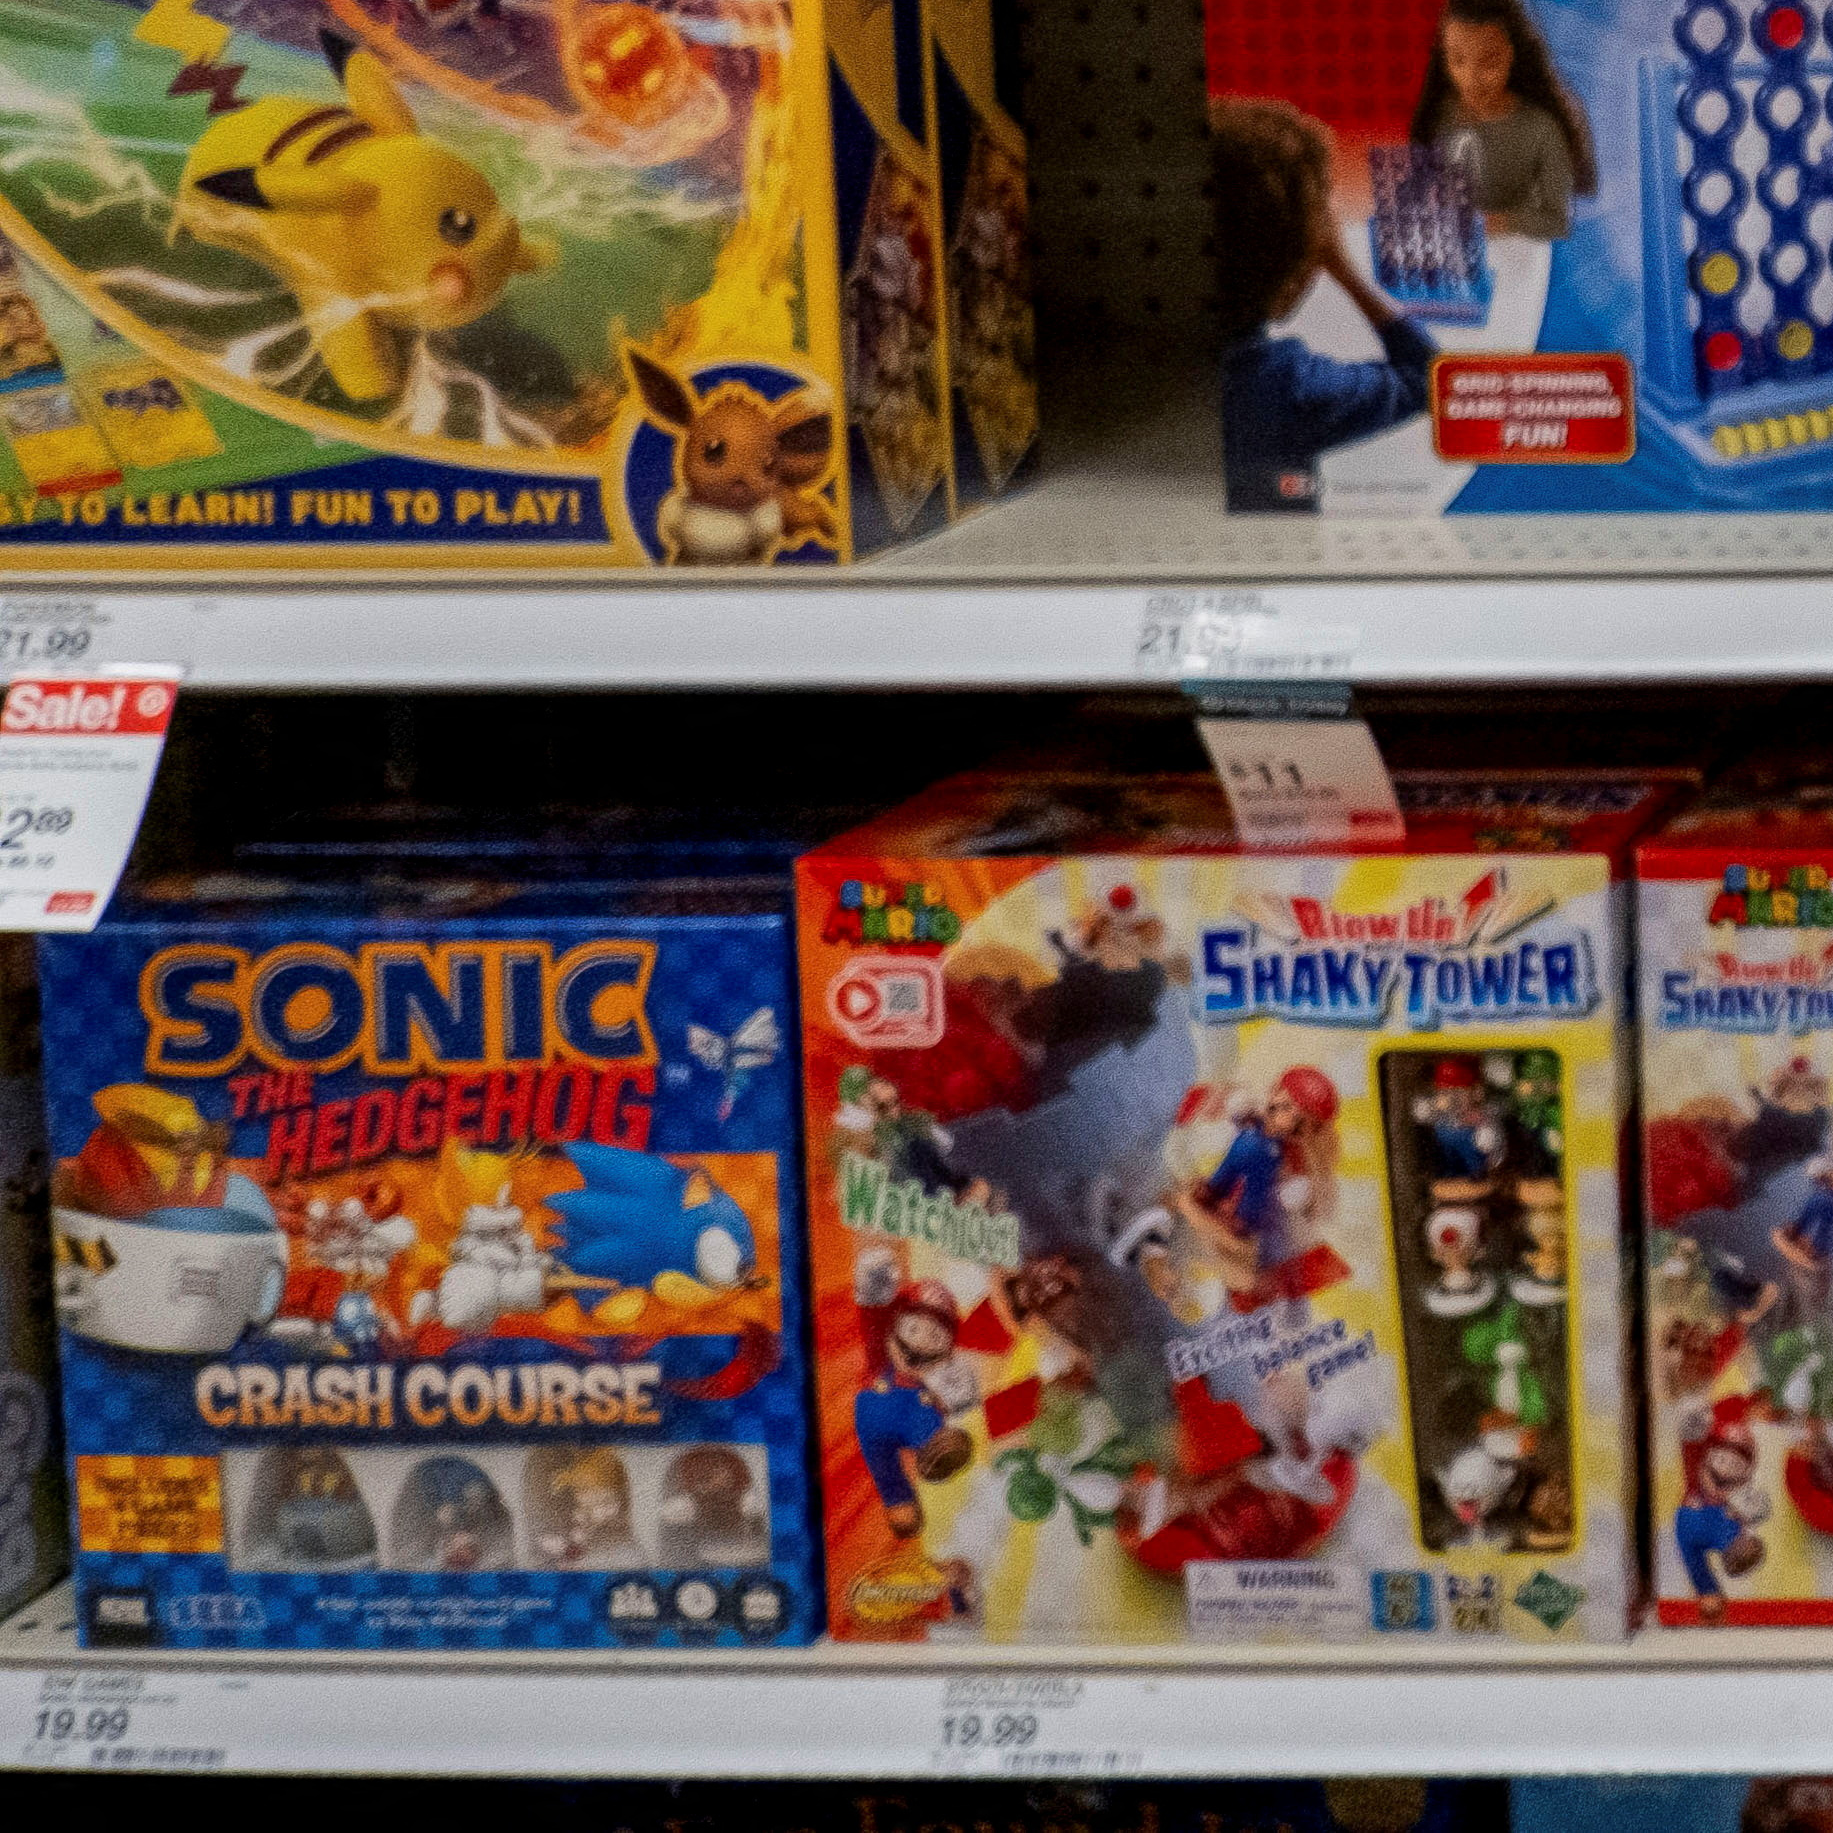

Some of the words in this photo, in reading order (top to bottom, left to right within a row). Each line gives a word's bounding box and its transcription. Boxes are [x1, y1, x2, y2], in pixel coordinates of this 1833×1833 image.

[56, 493, 107, 525] TO
[122, 491, 275, 525] LEARN!
[290, 493, 378, 523] FUN
[387, 493, 440, 523] TO
[454, 492, 581, 524] PLAY!
[2, 684, 126, 732] Sale!
[1204, 930, 1391, 1015] SHAKY
[1404, 932, 1585, 1011] TOWER
[152, 949, 652, 1068] SONIC
[227, 1065, 313, 1120] THE
[265, 1059, 656, 1187] HEDGEHOG
[198, 1364, 394, 1428] CRASH
[404, 1363, 663, 1427] COURSE
[33, 1709, 129, 1742] 19.99
[941, 1713, 1040, 1748] 19.99
